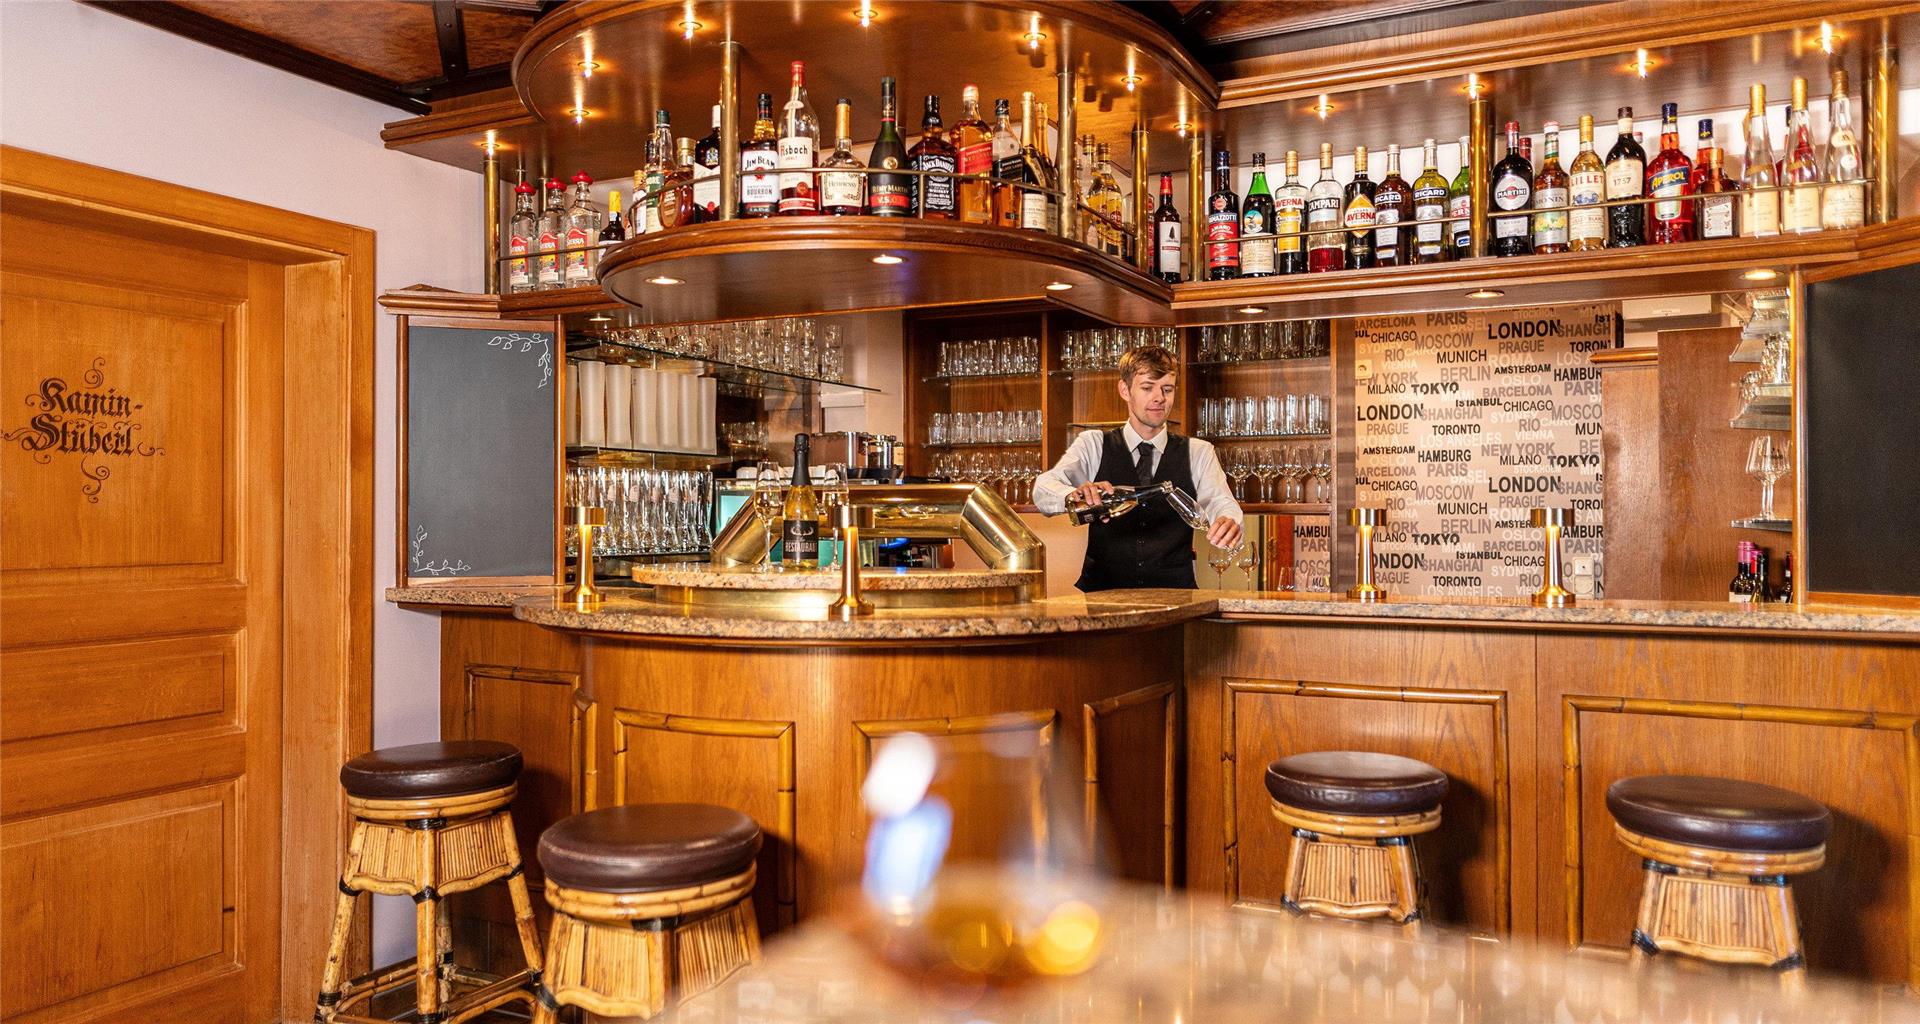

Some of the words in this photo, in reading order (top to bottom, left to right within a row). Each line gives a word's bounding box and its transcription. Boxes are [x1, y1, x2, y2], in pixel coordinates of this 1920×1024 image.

[1570, 174, 1604, 187] LILLET
[1613, 177, 1632, 187] 1757
[1651, 171, 1686, 190] APEROL
[1414, 189, 1445, 199] RICARD
[1497, 187, 1528, 199] MARTINI
[1346, 211, 1377, 222] AVERNA
[1354, 316, 1417, 330] BARCELONA
[1426, 311, 1469, 326] PARIS
[1487, 319, 1560, 340] LONDON
[1370, 331, 1417, 344] CHICAGO
[1415, 332, 1474, 350] MOSCOW
[1498, 340, 1545, 355] PRAGUE
[1385, 348, 1405, 362] RIO
[1436, 349, 1487, 364] MUNICH
[1489, 353, 1535, 367] ROMA
[1556, 351, 1580, 367] LOS
[1440, 365, 1491, 382] BERLIN
[1494, 363, 1552, 375] AMSTERDAM
[1382, 371, 1419, 385] YORK
[1501, 375, 1542, 387] OSLO
[1367, 383, 1406, 395] MILANO
[1411, 382, 1459, 396] TOKYO
[1482, 384, 1553, 398] BARCELONA
[1455, 397, 1503, 408] ISTANBUL
[1503, 399, 1554, 412] CHICAGO
[1357, 403, 1424, 421] LONDON
[1420, 406, 1483, 421] SHANGHAI
[1366, 422, 1409, 436] PRAGUE
[1432, 424, 1481, 436] TORONTO
[1519, 418, 1541, 432] RIO
[1420, 434, 1444, 449] LOS
[1447, 431, 1503, 447] ANGELES
[1514, 429, 1555, 441] VIENNA
[1362, 445, 1416, 456] AMSTERDAM
[1417, 449, 1472, 463] HAMBURG
[1480, 443, 1512, 457] NEW
[1515, 441, 1556, 456] YORK
[1369, 454, 1407, 466] OSLO
[1499, 454, 1542, 466] MILANO
[1547, 454, 1600, 468] TOKYO
[1354, 466, 1417, 478] BARCELONA
[1426, 462, 1469, 477] PARIS
[1371, 480, 1418, 492] CHICAGO
[1488, 475, 1561, 493] LONDON
[1415, 485, 1475, 501] MOSCOW
[1385, 497, 1406, 511] RIO
[1437, 502, 1488, 516] MUNICH
[1499, 495, 1545, 509] PRAGUE
[1389, 509, 1419, 520] IENNA
[1441, 518, 1492, 535] BERLIN
[1494, 519, 1532, 529] AMSTER
[1411, 533, 1460, 546] TOKYO
[1502, 528, 1543, 541] OSLO
[1483, 540, 1545, 553] BARCELON
[1373, 553, 1425, 569] ONDON
[1456, 550, 1504, 560] ISTANBUL
[1503, 555, 1546, 567] CHICAG
[1421, 559, 1483, 572] SHANGHAI
[1375, 571, 1410, 585] RAGUE
[1432, 575, 1482, 587] TORONTO
[1519, 574, 1542, 588] RIO
[1420, 584, 1444, 597] LOS
